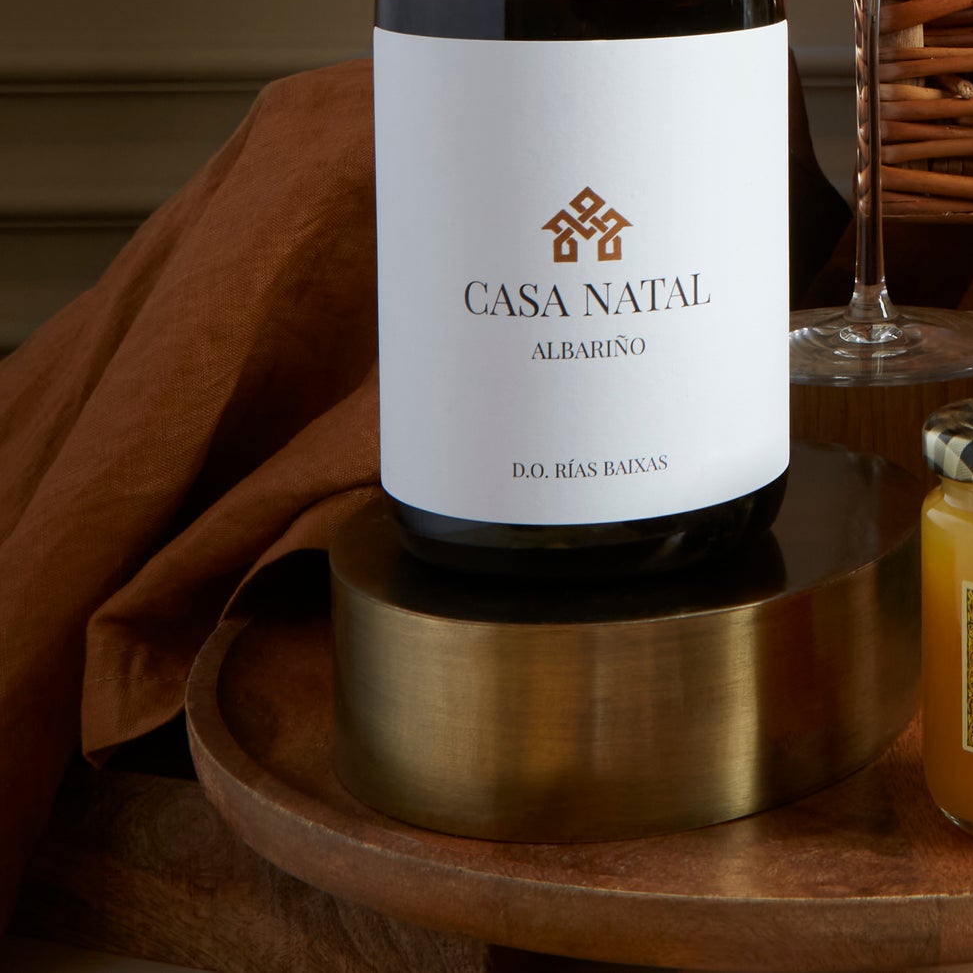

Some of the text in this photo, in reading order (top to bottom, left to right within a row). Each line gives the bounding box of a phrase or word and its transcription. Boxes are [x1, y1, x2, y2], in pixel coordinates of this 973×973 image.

[464, 273, 711, 318] CASA NATAL
[531, 334, 646, 360] ALBARIÑO
[512, 454, 668, 479] D.O. RÍAS BAIXAS
